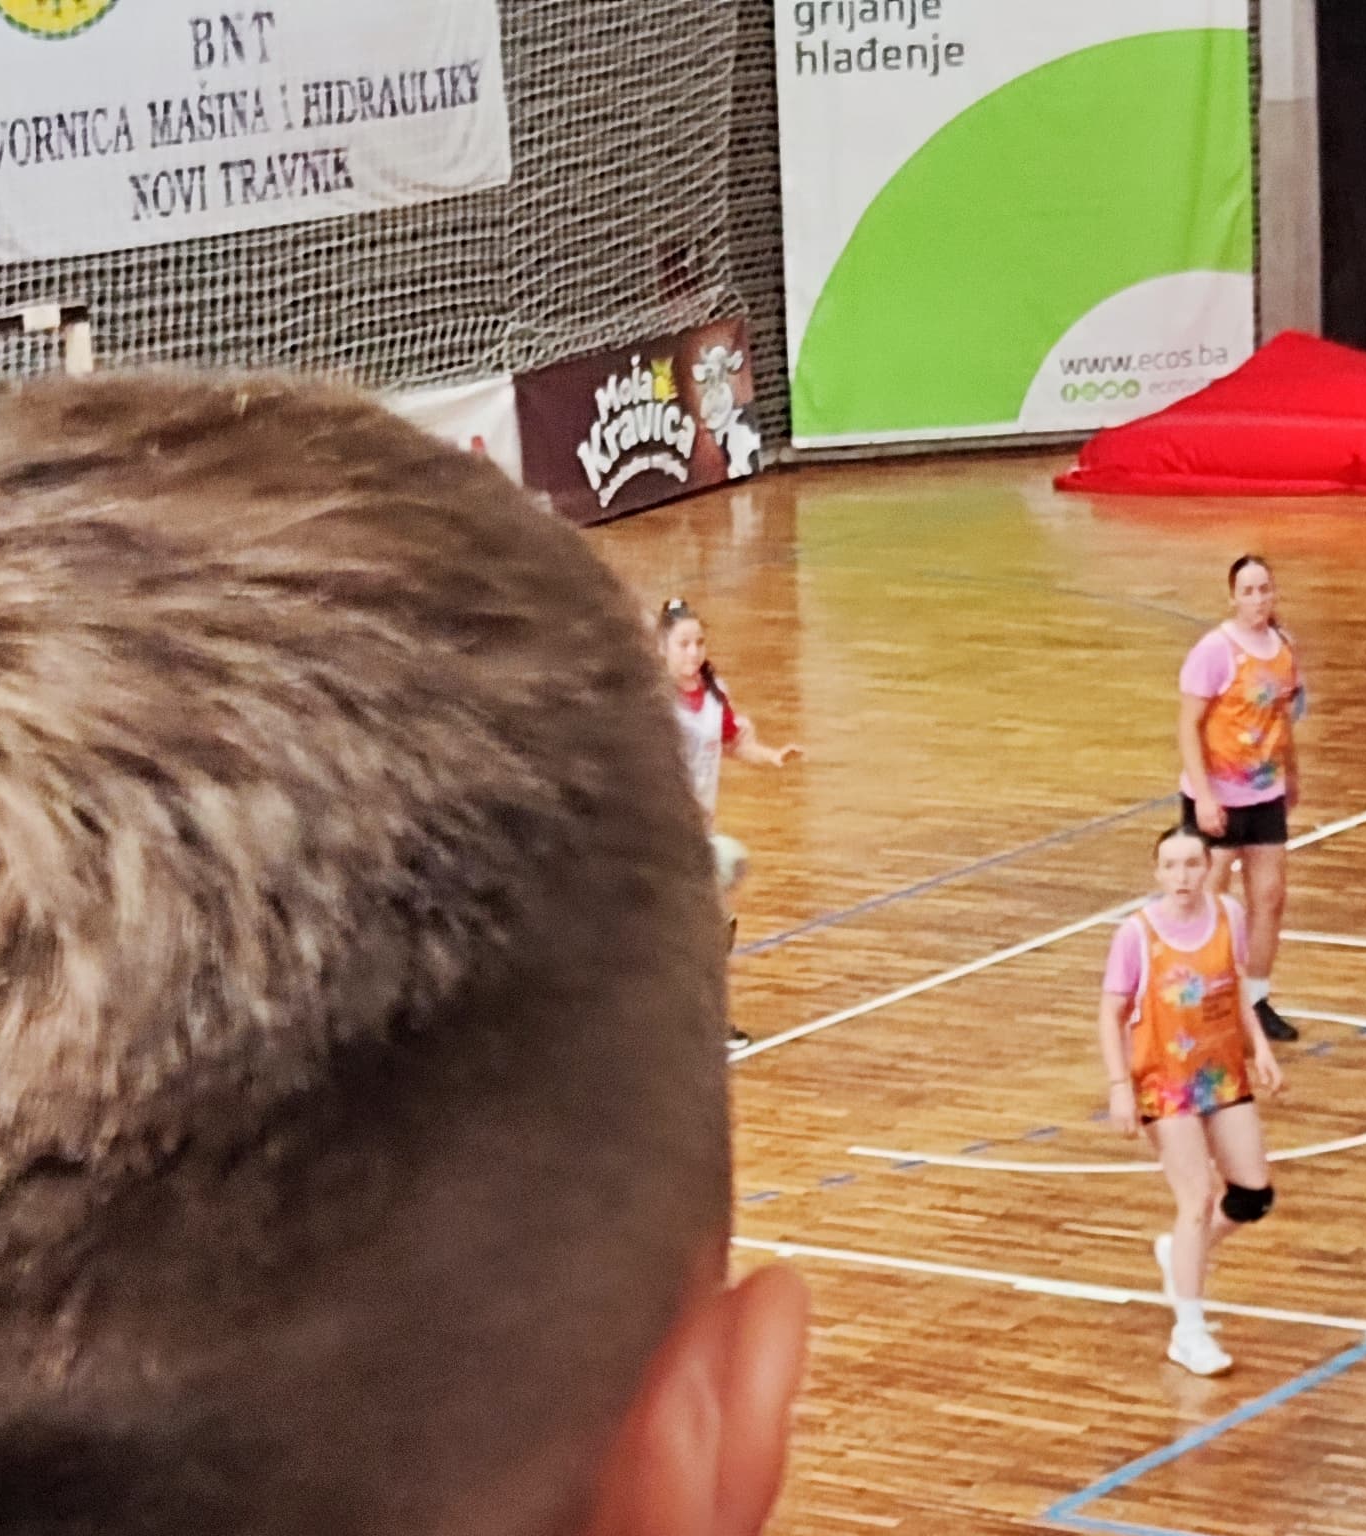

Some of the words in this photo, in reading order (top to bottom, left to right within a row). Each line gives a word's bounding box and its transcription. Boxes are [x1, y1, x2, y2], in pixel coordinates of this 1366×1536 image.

[189, 11, 275, 70] BNT
[793, 0, 942, 36] grijanje
[795, 33, 965, 77] hlađenje
[146, 80, 270, 149] MAŠINA
[128, 165, 207, 221] NOVI
[219, 147, 355, 208] TRAVNIK
[595, 354, 654, 424] Moja
[1059, 346, 1230, 376] www.ecos.ba
[577, 402, 696, 491] Kravica
